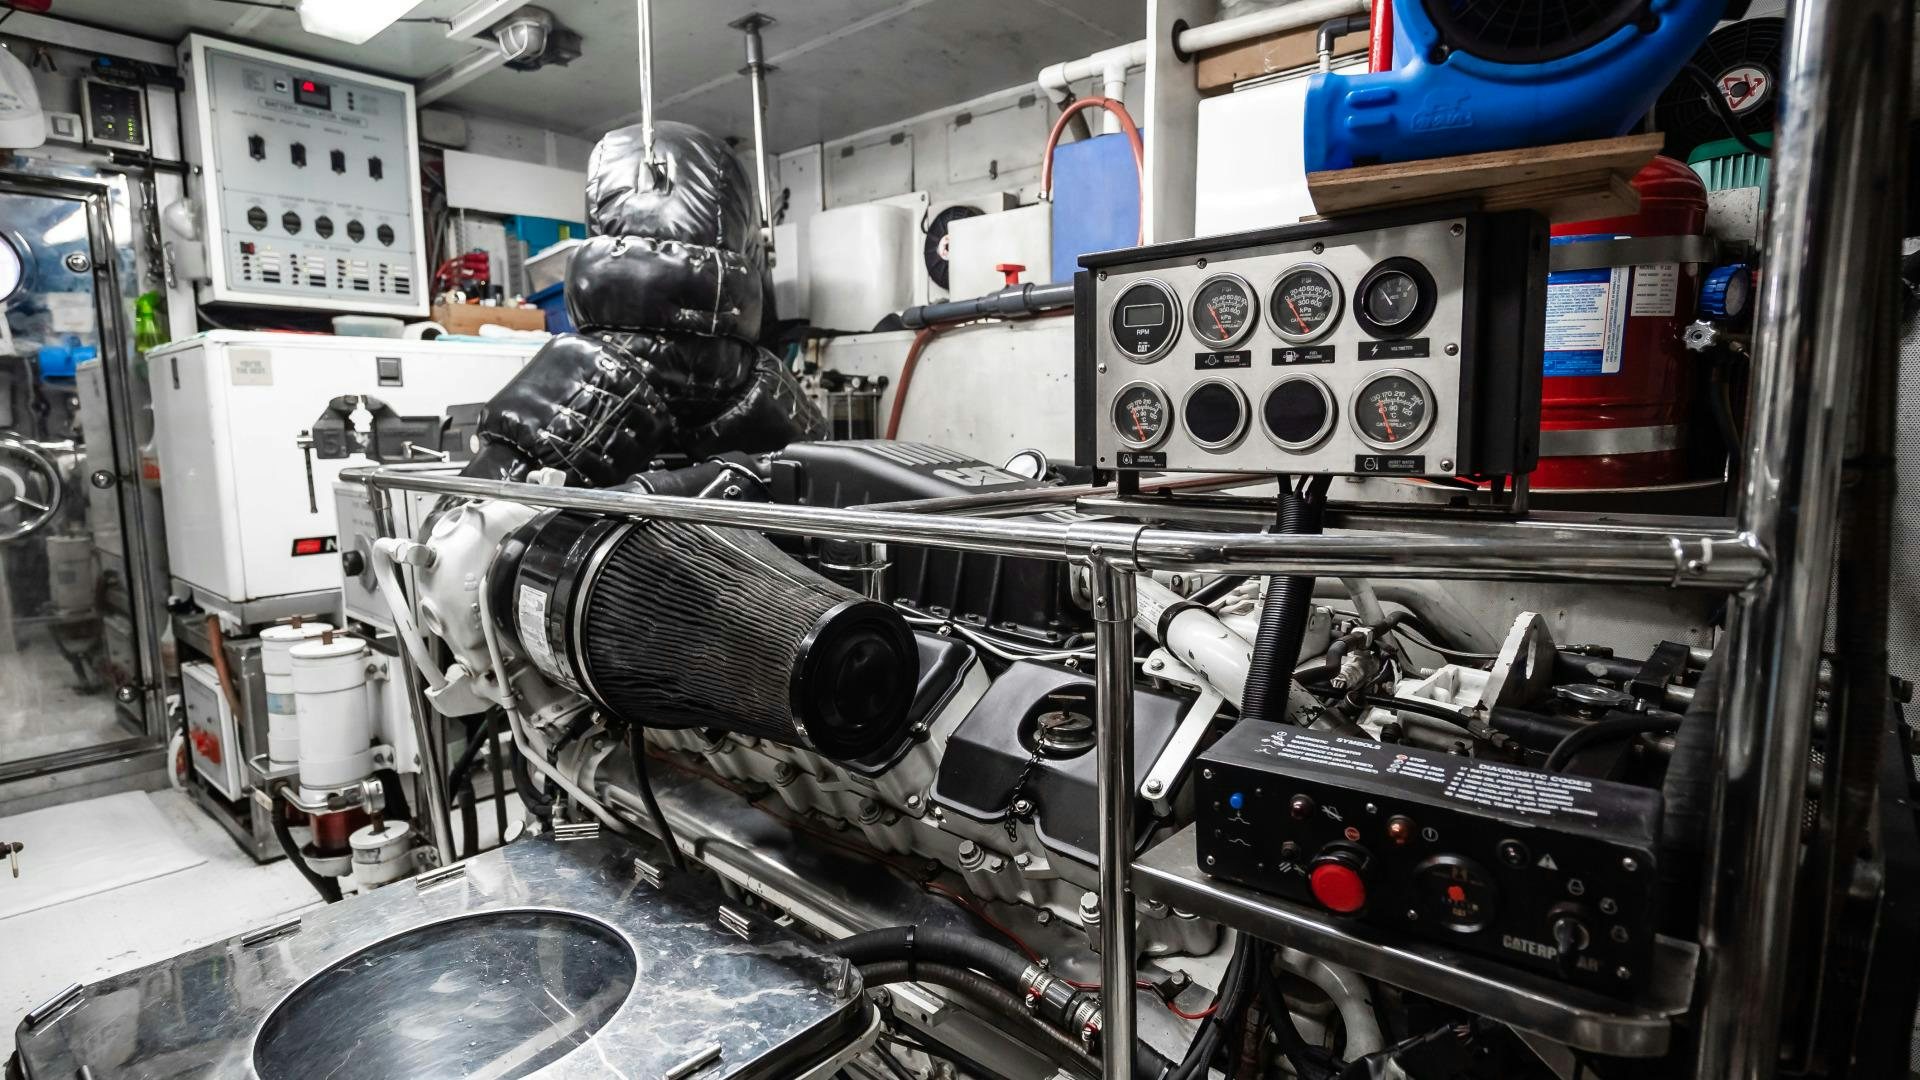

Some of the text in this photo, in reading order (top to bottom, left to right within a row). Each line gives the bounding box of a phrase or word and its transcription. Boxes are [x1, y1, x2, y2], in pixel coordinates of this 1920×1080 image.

[1310, 299, 1322, 308] 600
[1402, 407, 1413, 416] 120
[932, 465, 1025, 487] CAT
[1291, 739, 1330, 750] MAINTENANCE
[1295, 735, 1329, 745] DIAGNOSTIC
[1336, 737, 1382, 750] SYMBOLS
[1287, 743, 1327, 754] MAINTENANCE
[1401, 765, 1446, 778] ENGINE STOP
[1404, 761, 1430, 770] ENGINE
[1398, 770, 1446, 783] ENGINE START
[1470, 768, 1502, 778] BATTERY
[1501, 774, 1533, 784] VOLTAGE
[1534, 779, 1561, 788] BELOW
[1478, 763, 1593, 788] DIAGNOSTIC CODES
[1464, 777, 1483, 786] HIGH
[1482, 782, 1517, 793] COOLANT
[1539, 791, 1575, 802] WARNING
[1496, 778, 1535, 790] PRESSURE
[1534, 785, 1570, 796] WARNING
[1461, 783, 1478, 791] LOW
[1478, 787, 1513, 798] COOLANT
[1512, 793, 1537, 802] LEVEL
[1537, 797, 1573, 808] WARNING
[1454, 793, 1474, 802] HIGH
[1473, 797, 1492, 806] FUEL
[1515, 805, 1551, 816] WARNING
[1457, 788, 1477, 797] HIGH
[1560, 806, 1598, 817] WARNING
